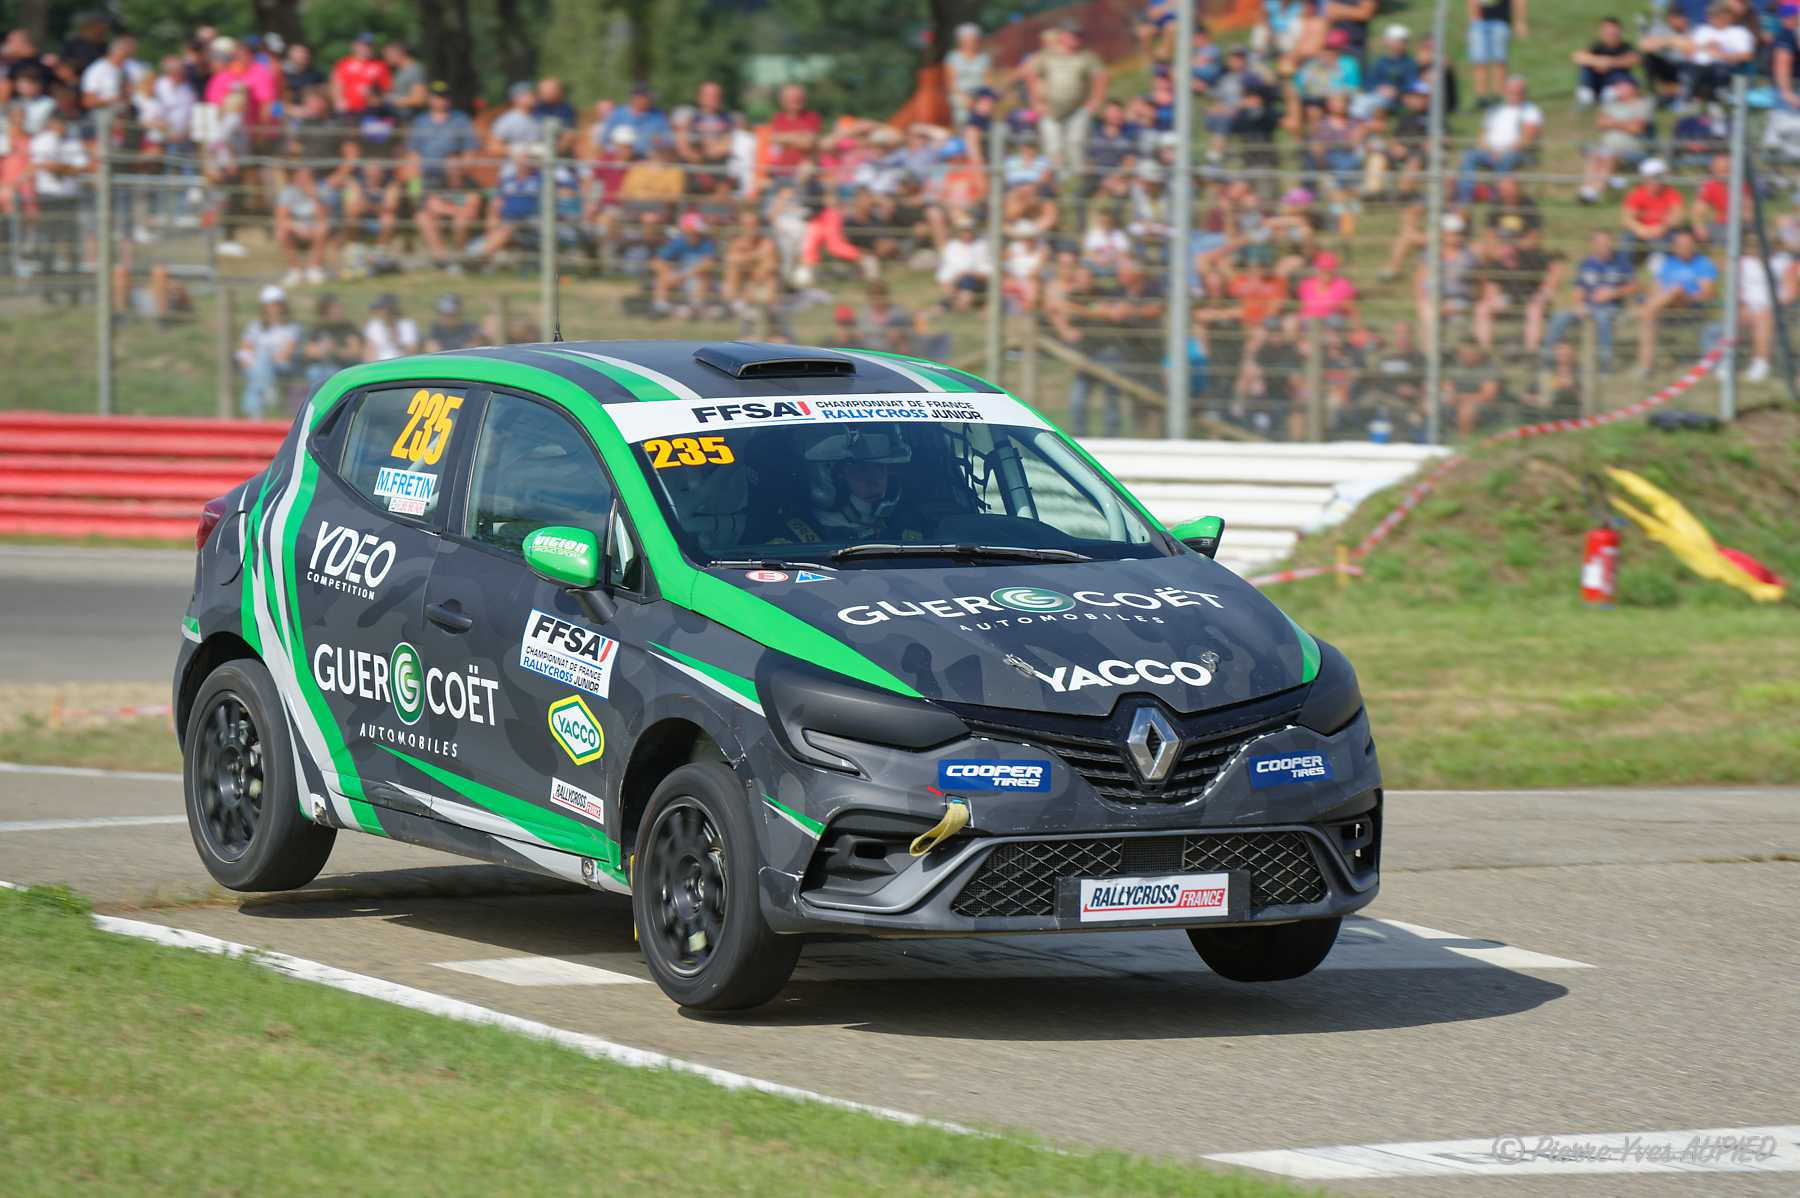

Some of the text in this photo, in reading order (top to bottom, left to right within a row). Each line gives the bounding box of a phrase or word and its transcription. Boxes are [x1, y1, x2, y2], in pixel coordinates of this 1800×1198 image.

[691, 401, 801, 423] FFSA
[815, 399, 975, 409] CHAMPIONNAT DE FRANCE
[822, 409, 984, 420] RALLYCROSS JUNIOR
[391, 389, 464, 465] 235
[644, 437, 735, 469] 235
[376, 471, 434, 498] M.FRETIN
[309, 520, 397, 588] YDEO
[307, 571, 375, 600] COMPETITION
[959, 613, 1166, 632] AUTOMOBILES
[531, 614, 603, 662] FFSA
[523, 656, 600, 693] RALLYCROSS JUNIOR
[525, 645, 602, 681] CHAMPIONNAT DE FRANCE
[1033, 659, 1213, 693] YACCO
[359, 722, 458, 758] AUTOMOBILES
[557, 714, 596, 747] YACCO
[946, 764, 1044, 778] COOPER
[1256, 756, 1323, 773] COOPER
[1291, 765, 1326, 779] TIRES
[556, 784, 587, 808] RALLYCROSS
[992, 777, 1041, 788] TIRES
[1090, 884, 1225, 908] RALLYCROSS FRANCE
